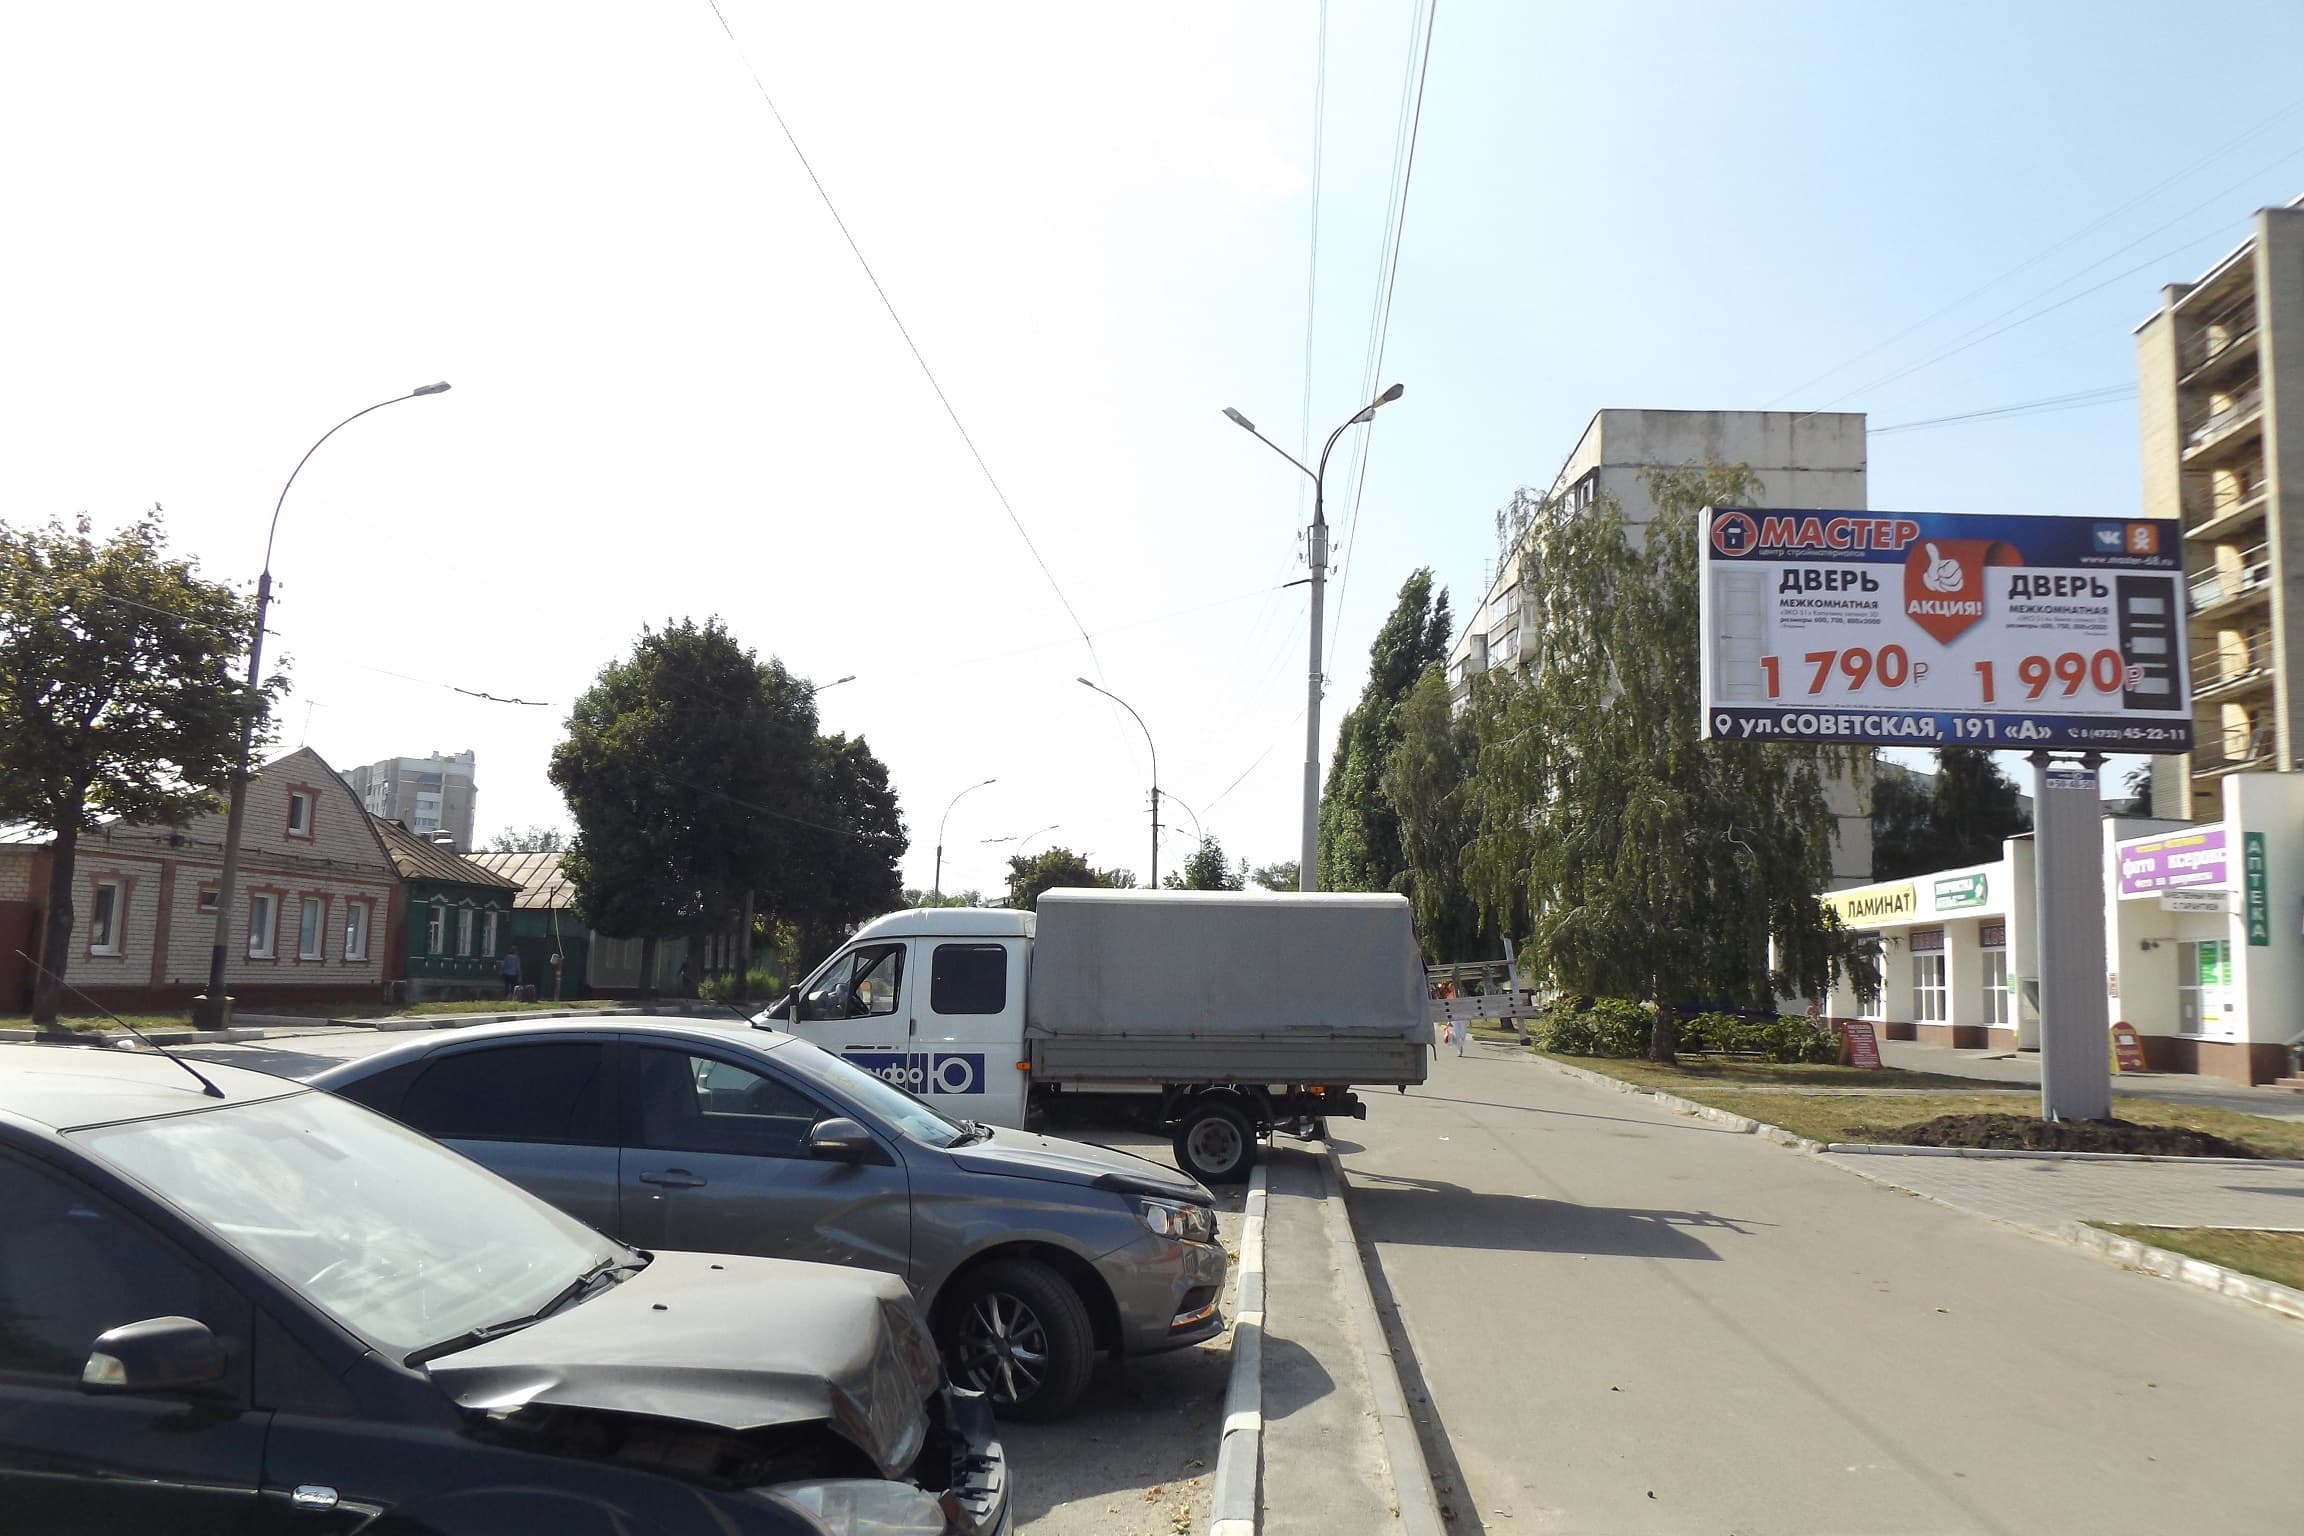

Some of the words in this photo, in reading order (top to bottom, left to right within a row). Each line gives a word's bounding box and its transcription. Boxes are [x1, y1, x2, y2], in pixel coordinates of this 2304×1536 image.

[1759, 517, 1920, 550] МАСТЕР
[1779, 568, 1879, 594] ДВЕРЬ
[2008, 575, 2109, 600] ДВЕРЬ
[1779, 599, 1879, 609] МЕЖКОМНАТНАЯ
[1908, 600, 1982, 617] АКЦИЯ!
[2009, 605, 2109, 615] МЕЖКОМНАТНАЯ
[1952, 718, 1996, 739] 191
[2004, 719, 2052, 740] «А»
[2123, 727, 2186, 740] 45-22-11
[2247, 840, 2267, 937] АПТЕКА
[1848, 892, 1910, 918] ЛАМИНАТ
